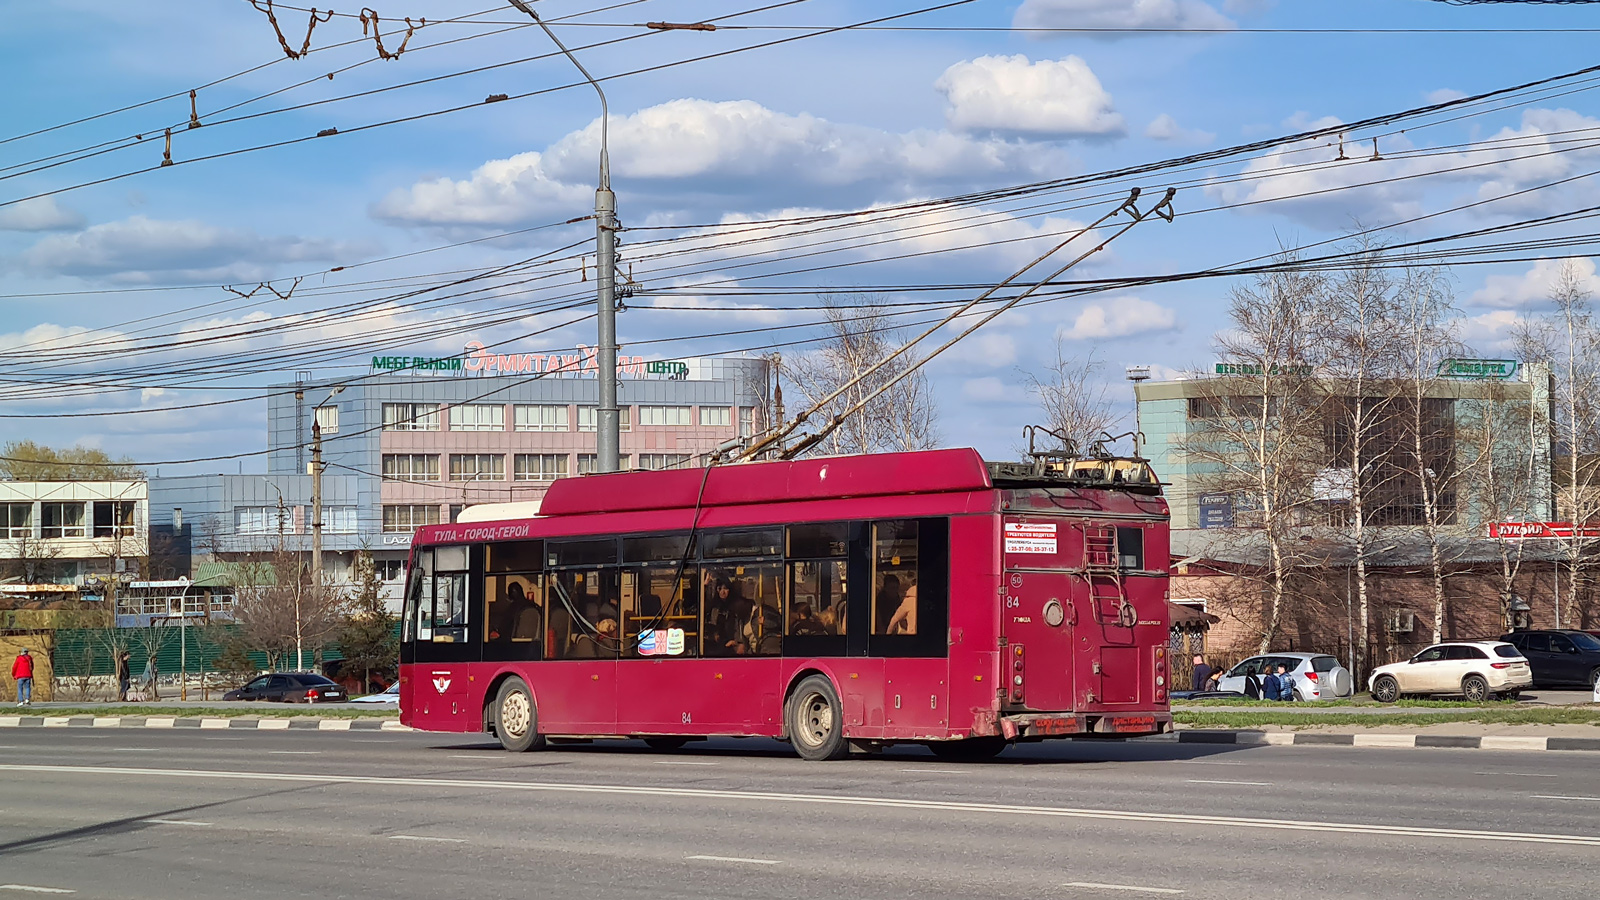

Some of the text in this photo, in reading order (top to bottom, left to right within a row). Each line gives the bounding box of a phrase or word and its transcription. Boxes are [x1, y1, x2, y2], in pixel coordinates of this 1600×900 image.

[372, 356, 461, 371] МЕБЕЛЬНЫЙ
[647, 361, 687, 374] ЦЕНТР
[434, 530, 457, 542] ТУЛА
[464, 523, 530, 541] ГОРОД-ГЕРОЙ
[1012, 576, 1022, 585] 50
[1006, 595, 1020, 608] 84
[682, 712, 691, 724] 84
